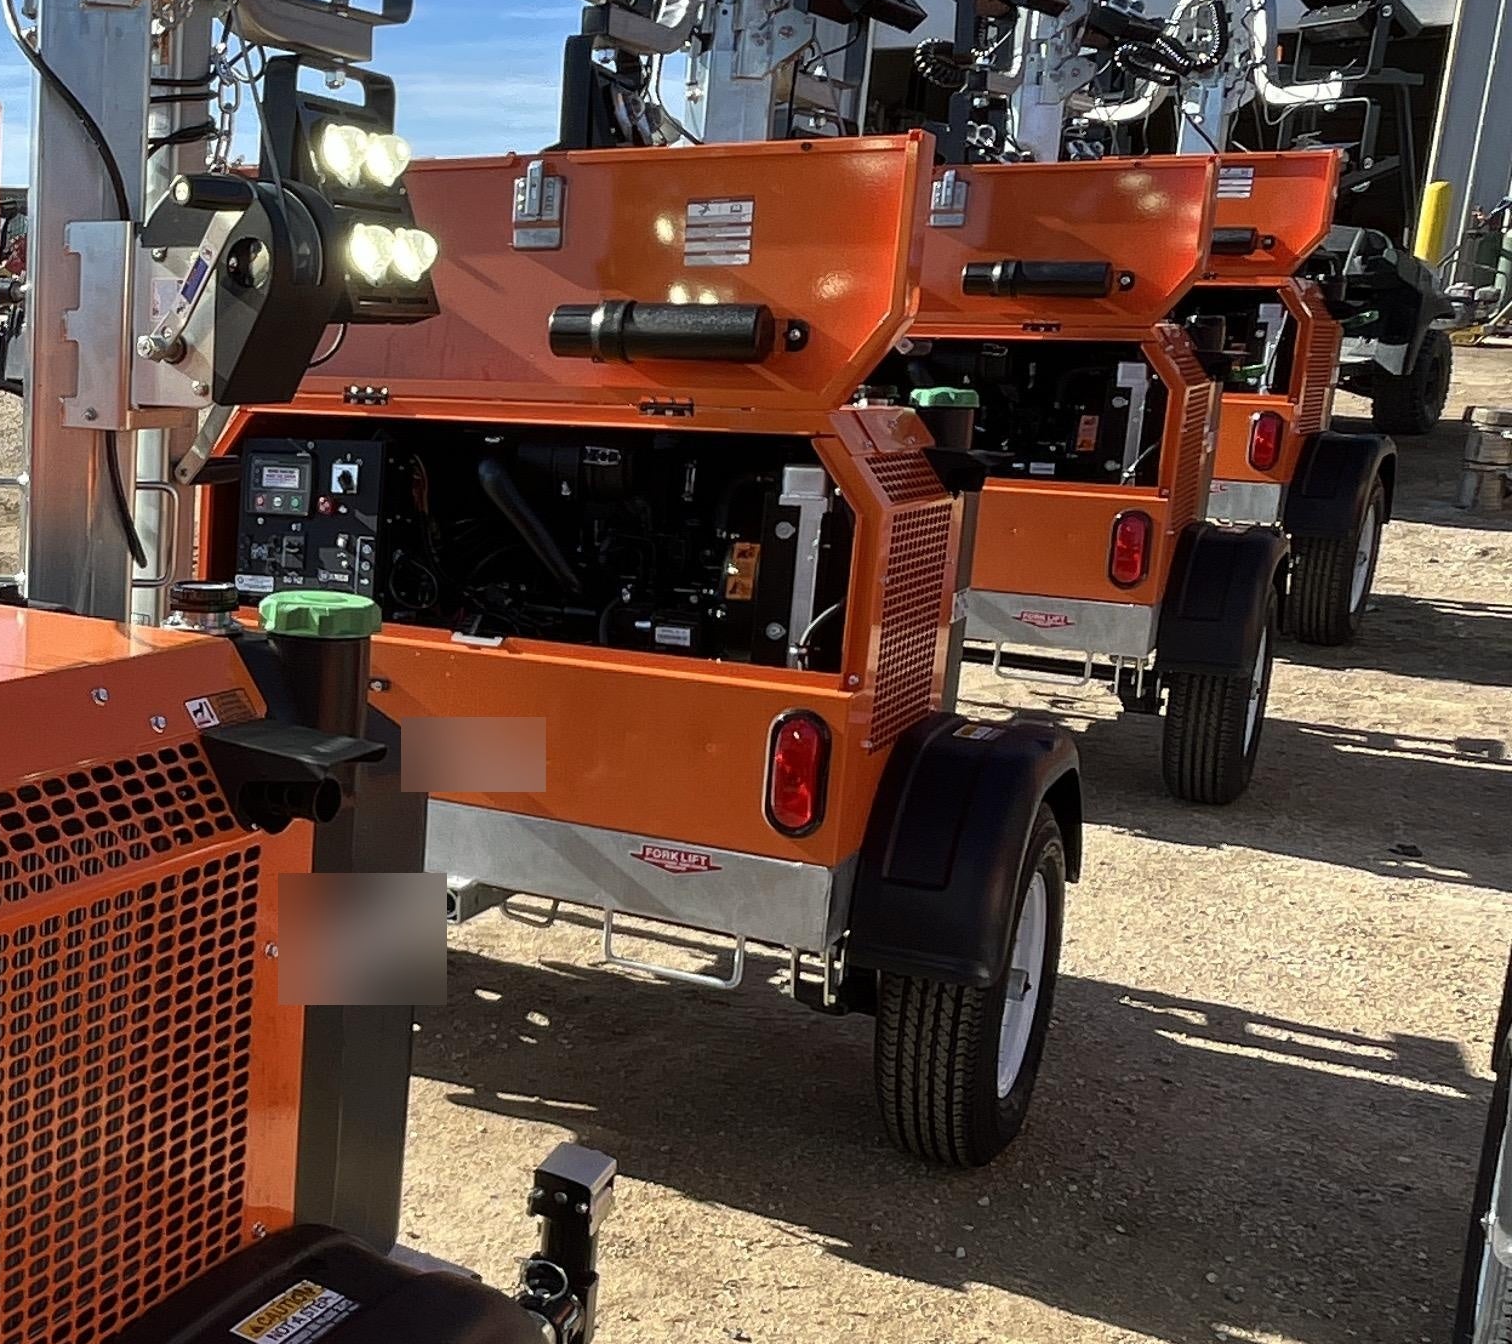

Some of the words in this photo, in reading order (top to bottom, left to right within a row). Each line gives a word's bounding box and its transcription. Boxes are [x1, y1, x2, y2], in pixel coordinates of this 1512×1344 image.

[644, 847, 679, 862] FORK
[680, 853, 708, 866] LIFT
[256, 1286, 317, 1328] CAUTION
[265, 1321, 296, 1342] NOT
[292, 1315, 306, 1327] A
[300, 1295, 334, 1319] STEP
